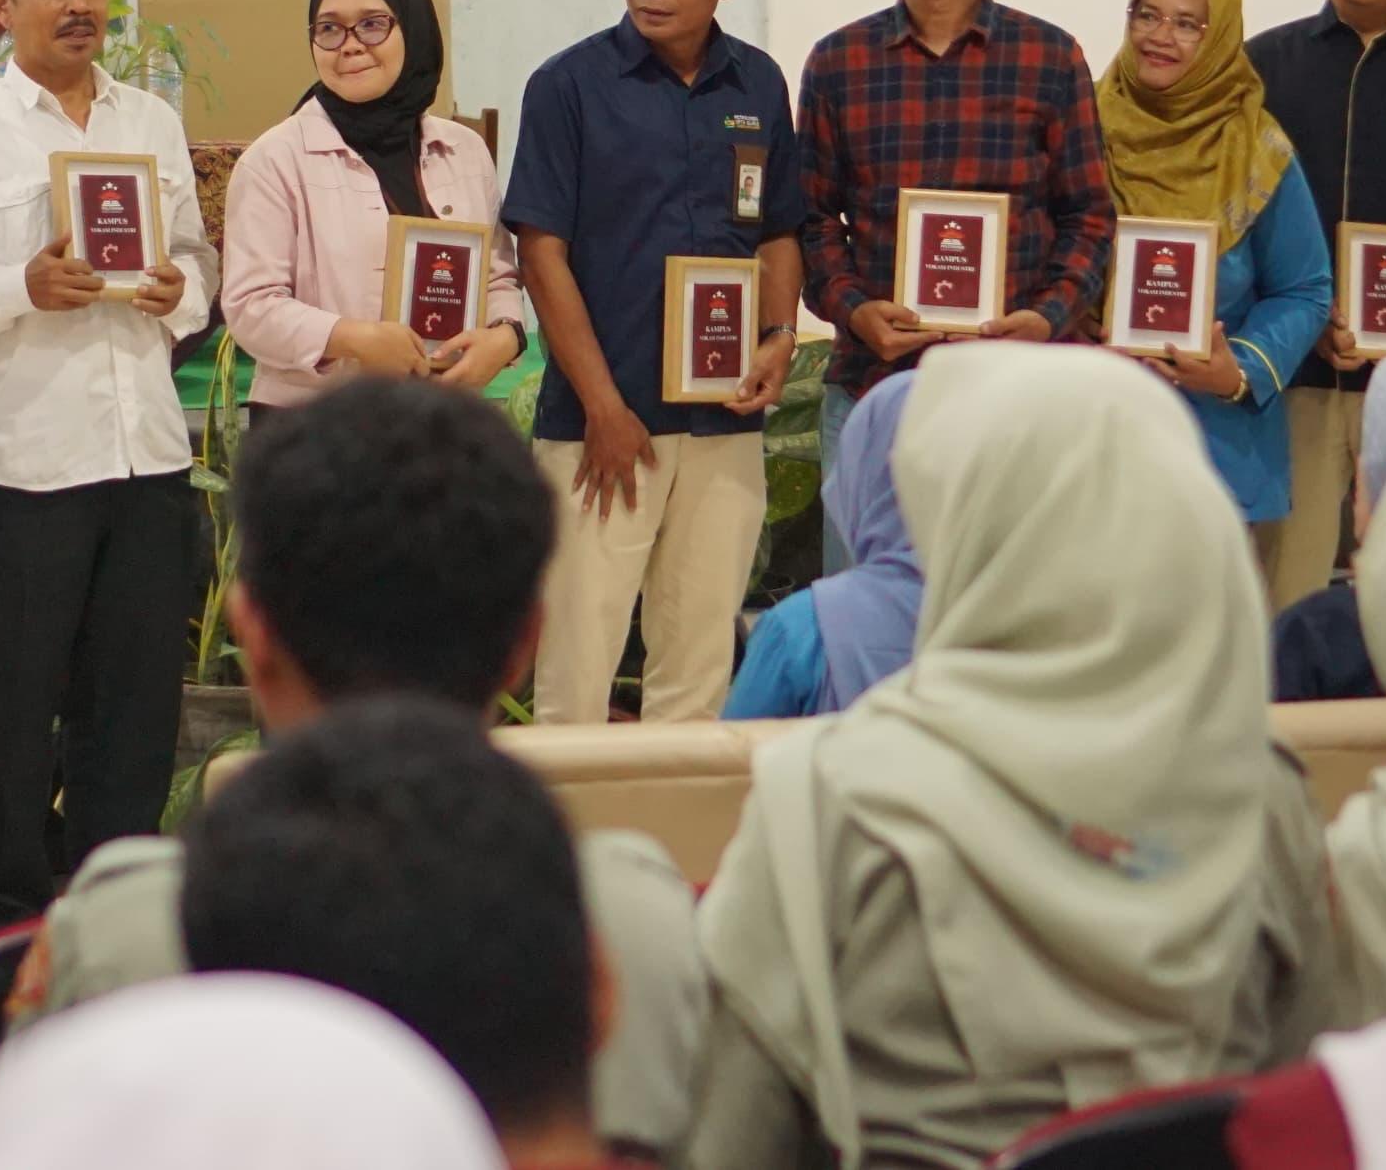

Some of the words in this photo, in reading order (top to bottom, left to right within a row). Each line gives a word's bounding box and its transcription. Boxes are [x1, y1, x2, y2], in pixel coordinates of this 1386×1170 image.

[97, 217, 129, 225] KAMPUS
[933, 254, 968, 263] KAMPUS
[1146, 279, 1180, 289] KAMPUS
